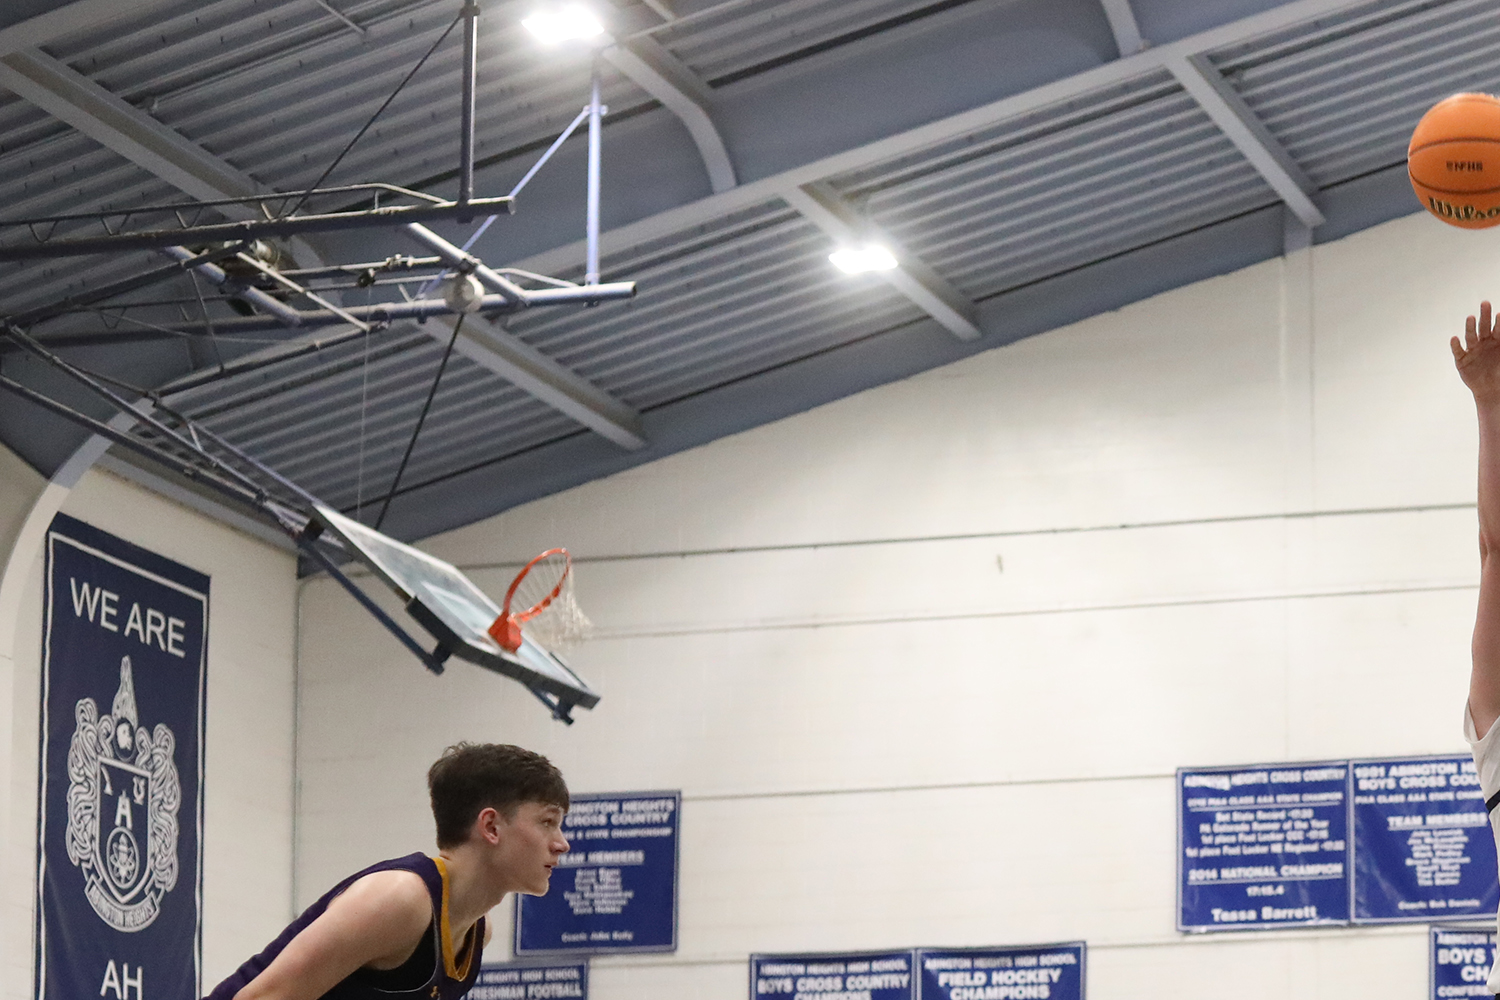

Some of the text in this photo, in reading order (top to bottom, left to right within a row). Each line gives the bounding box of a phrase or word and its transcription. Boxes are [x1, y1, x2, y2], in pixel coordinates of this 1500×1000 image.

[70, 577, 186, 658] WE ARE
[1388, 762, 1458, 777] ABINGTON
[1358, 777, 1396, 791] BOYS
[1400, 775, 1446, 789] CROSS
[621, 799, 676, 813] HEIGHTS
[564, 811, 671, 828] CROSS COUNTRY
[1386, 812, 1488, 827] TEAM MEMBERS
[587, 850, 647, 864] MEMBERS
[1220, 865, 1278, 879] NATIONAL
[1280, 862, 1344, 877] CHAMPION
[1211, 904, 1318, 923] Tessa Barrett
[871, 958, 908, 971] SCHOOL
[1039, 952, 1077, 966] SCHOOL
[1438, 947, 1486, 965] BOYS
[482, 971, 520, 984] HEIGHTS
[521, 970, 543, 981] HIGH
[545, 967, 580, 980] SCHOOL
[757, 972, 910, 994] BOYS CROSS COUNTRY
[938, 967, 1062, 987] FIELD HOCKEY
[527, 982, 582, 999] FOOTBALL
